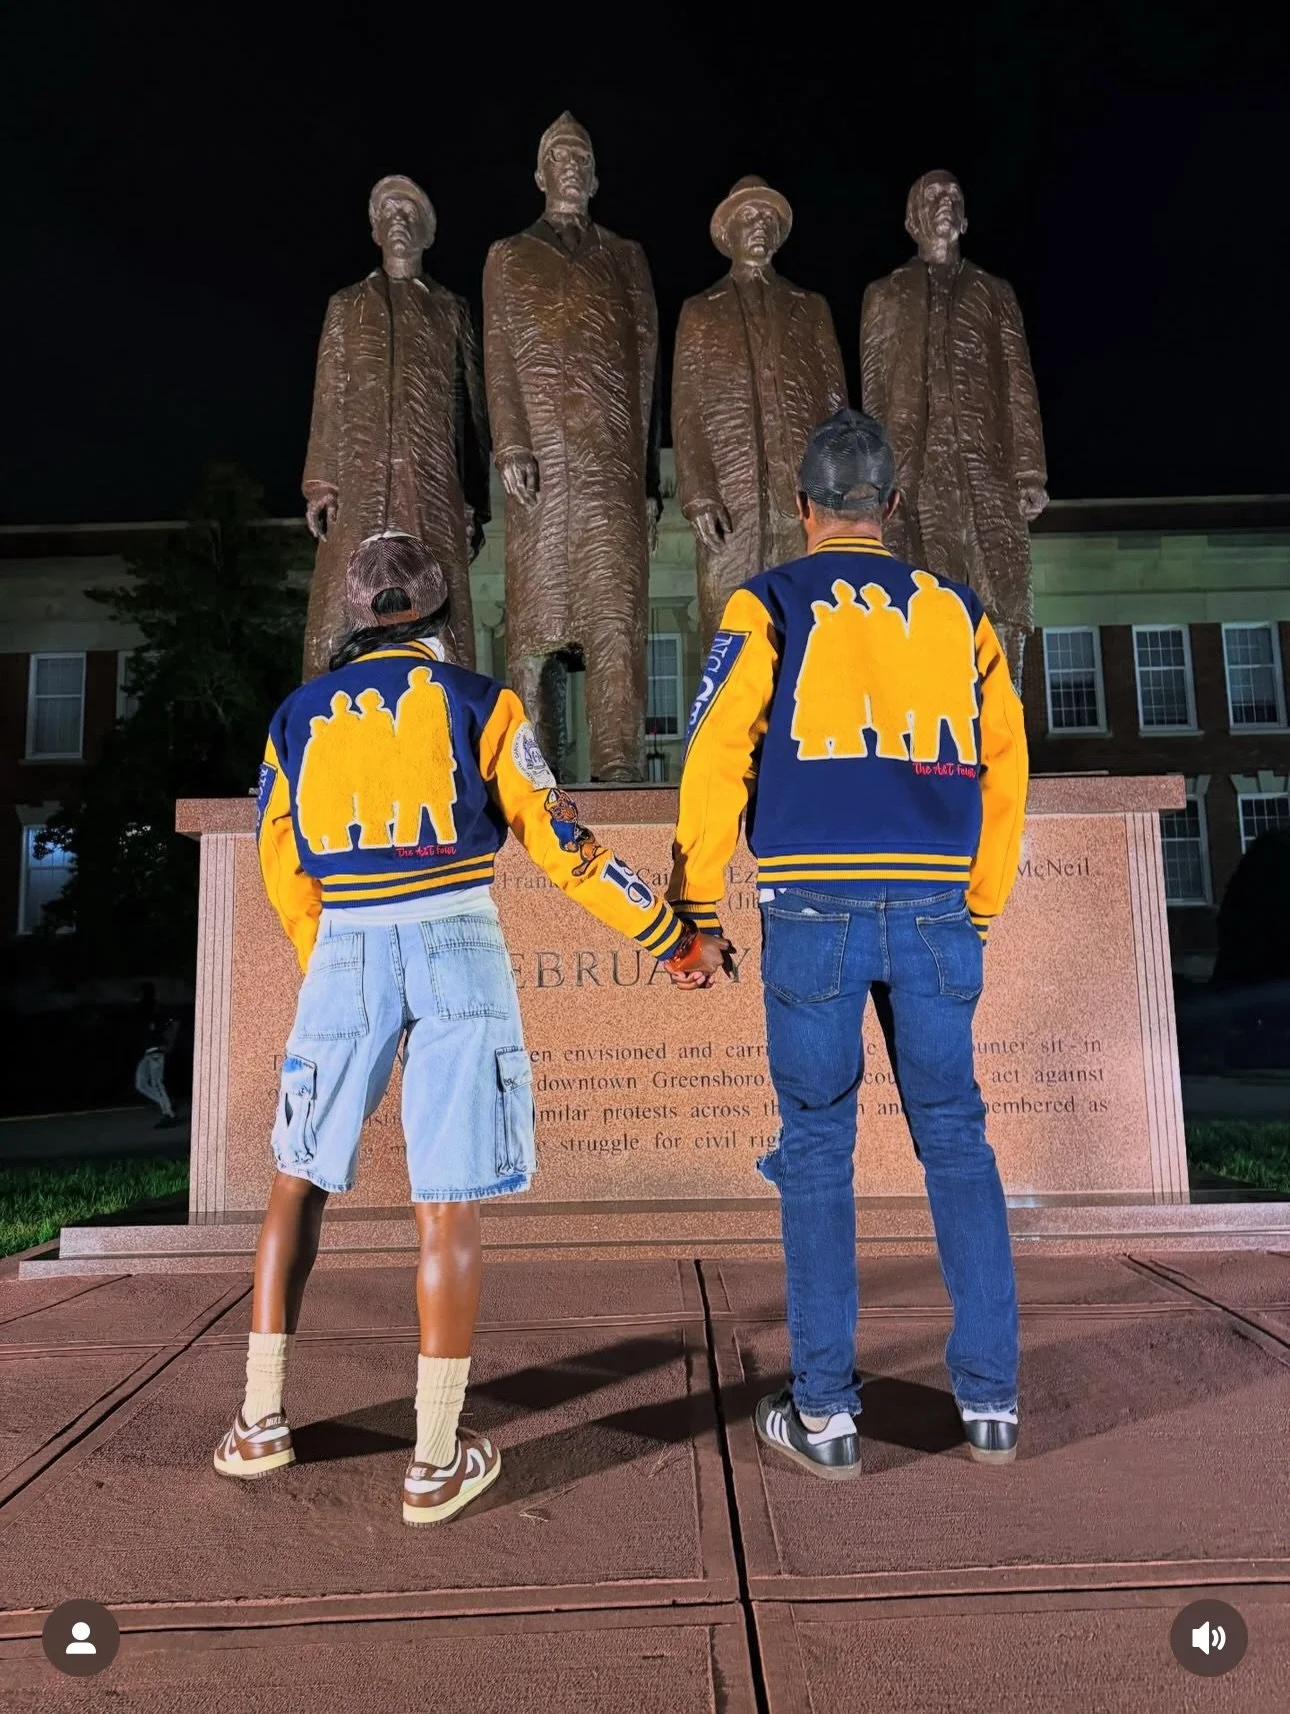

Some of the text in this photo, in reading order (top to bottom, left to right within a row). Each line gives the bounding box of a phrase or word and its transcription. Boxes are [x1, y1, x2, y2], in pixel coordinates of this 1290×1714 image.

[530, 1049, 552, 1062] en
[564, 1042, 666, 1061] envisioned
[679, 1041, 712, 1059] and
[725, 1044, 765, 1058] carr
[976, 1039, 1027, 1055] unter
[537, 1074, 637, 1091] downtown
[992, 1068, 1019, 1083] act
[1034, 1067, 1104, 1087] against
[540, 1103, 589, 1121] milar
[603, 1104, 677, 1124] protests
[691, 1104, 750, 1119] across
[878, 1102, 900, 1116] an
[1089, 1100, 1108, 1113] as
[560, 1133, 640, 1156] struggle
[655, 1131, 681, 1149] for
[695, 1130, 736, 1149] civil
[750, 1130, 777, 1150] rig
